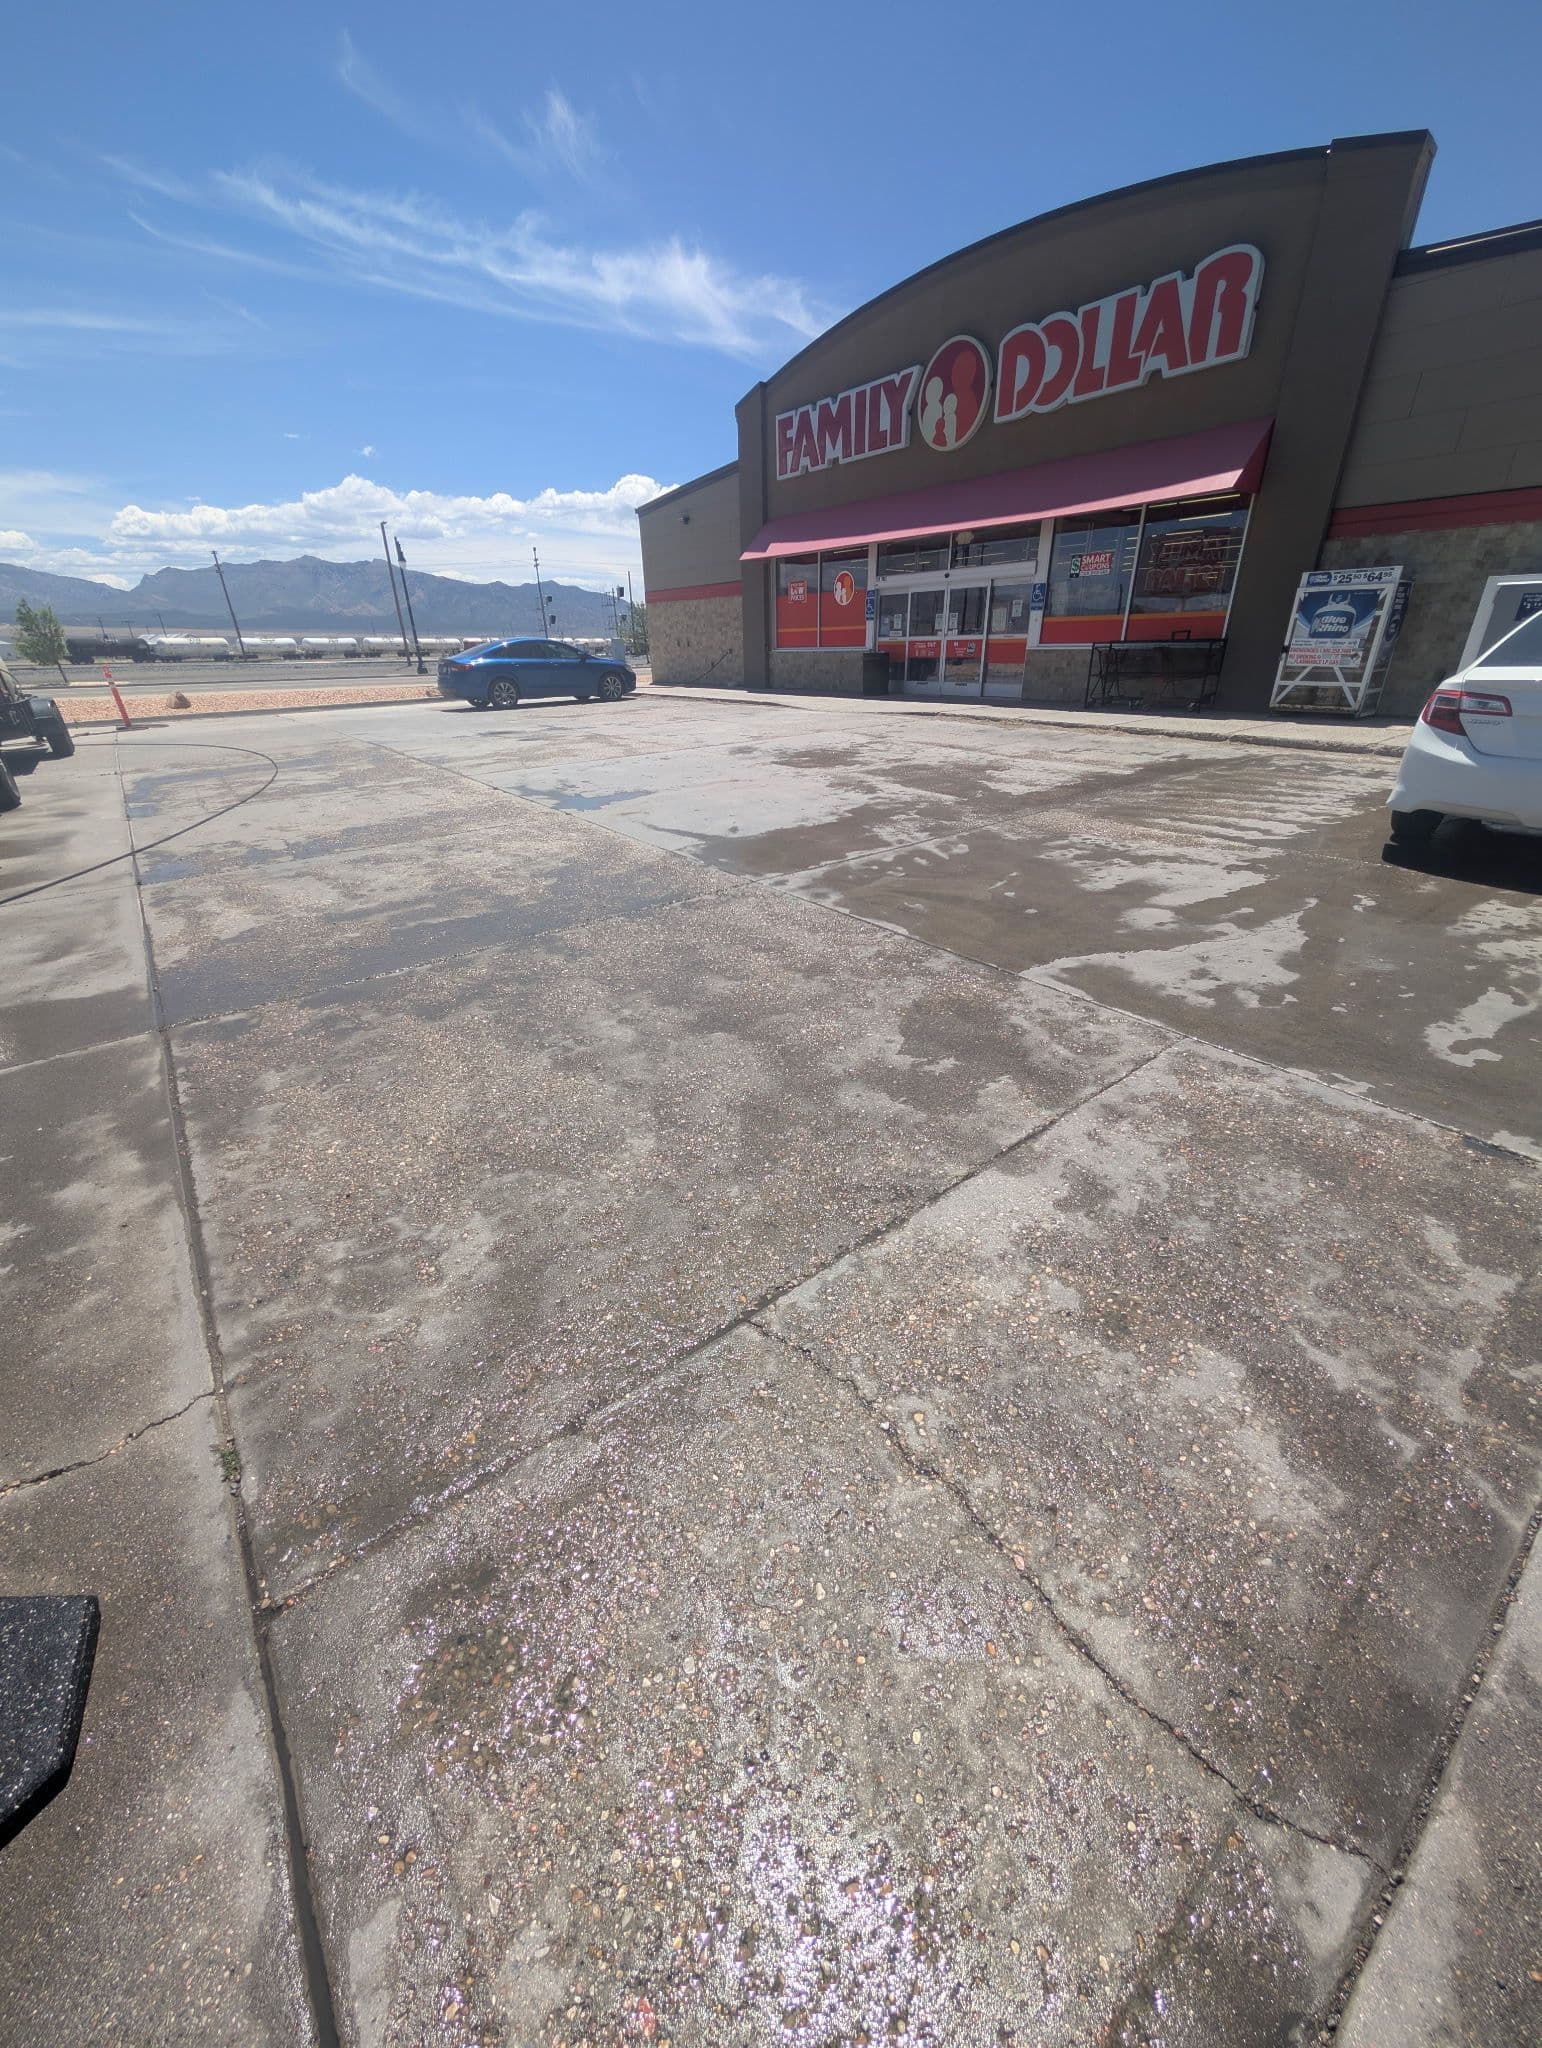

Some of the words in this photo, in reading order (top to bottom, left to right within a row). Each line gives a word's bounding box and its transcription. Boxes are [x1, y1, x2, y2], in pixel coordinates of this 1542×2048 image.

[777, 365, 922, 480] FAMILY
[993, 243, 1265, 424] DOLLAR
[1082, 553, 1112, 564] SMART
